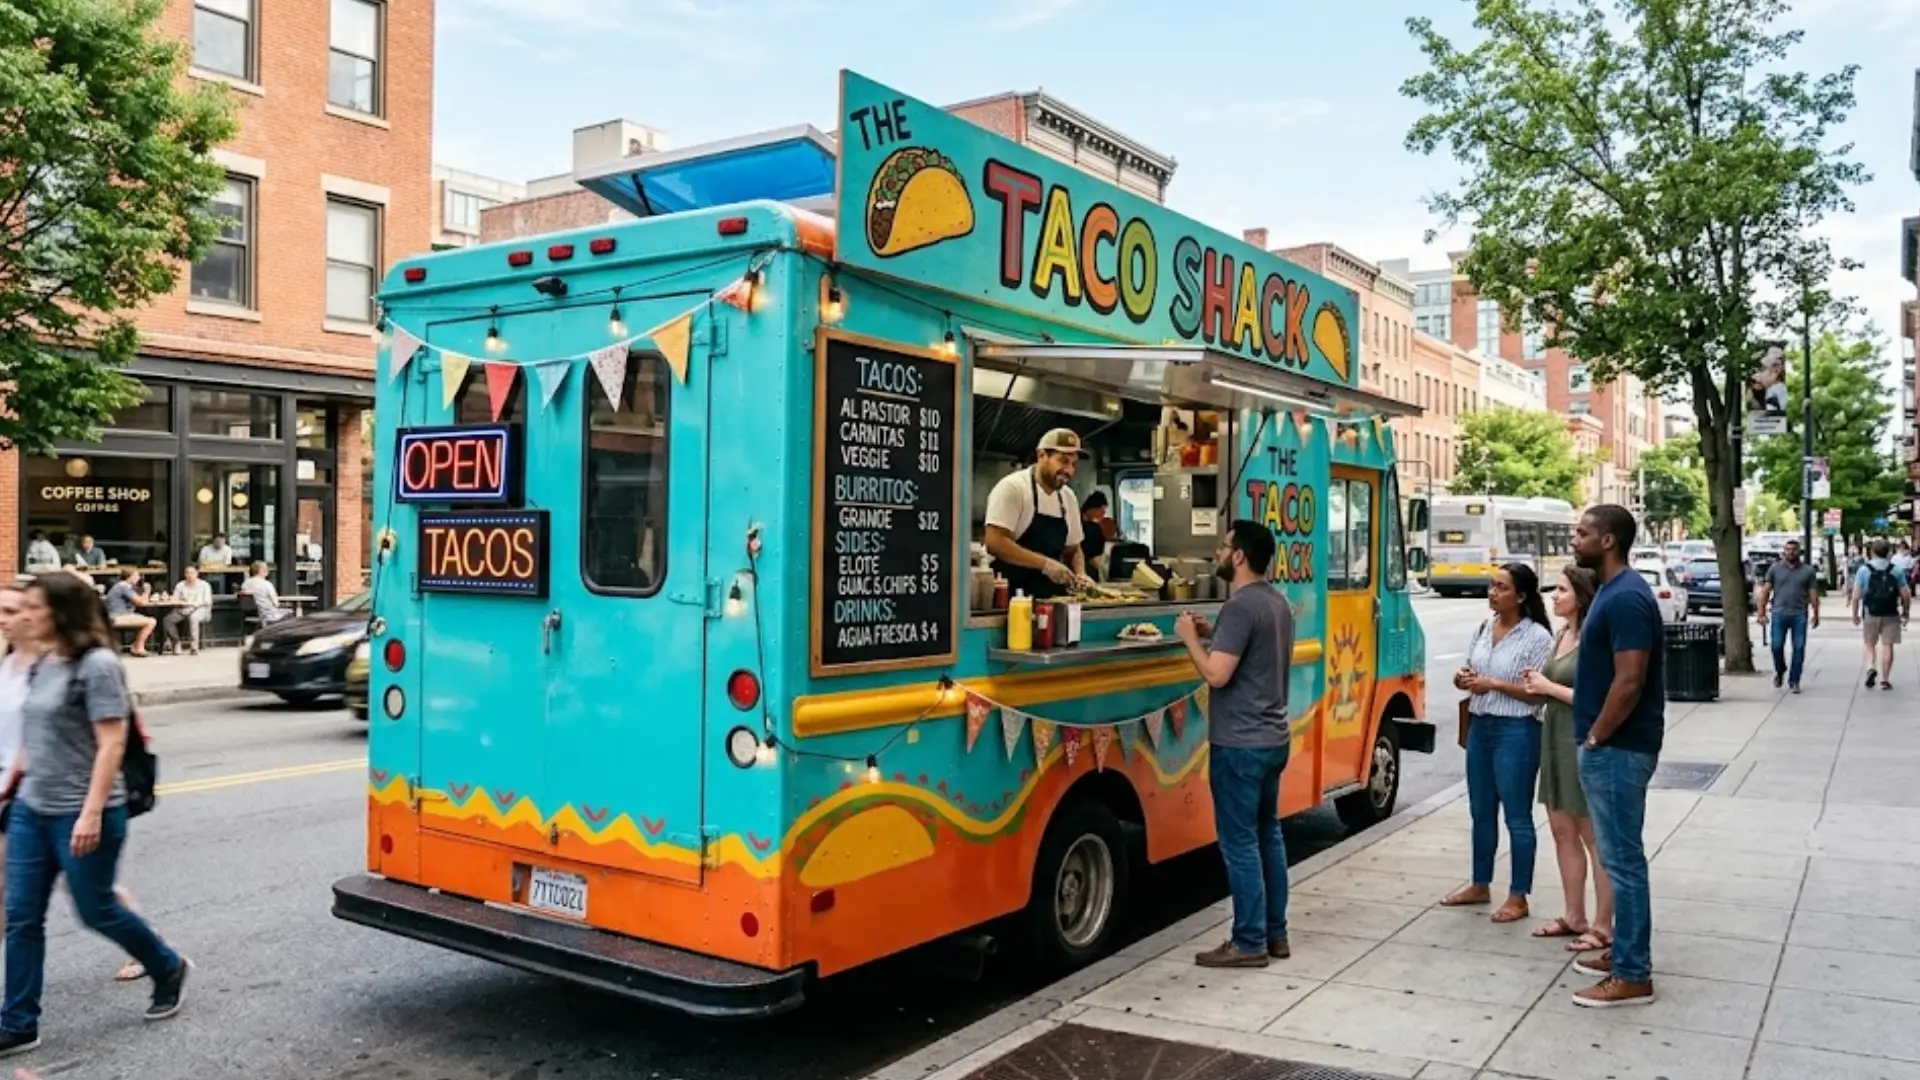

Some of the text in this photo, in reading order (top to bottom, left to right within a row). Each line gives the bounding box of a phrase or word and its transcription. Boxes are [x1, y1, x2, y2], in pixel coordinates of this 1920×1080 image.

[849, 99, 913, 150] THE
[983, 158, 1311, 371] TACO SHACK
[855, 357, 923, 395] TACOS:
[840, 398, 941, 429] AL PASTOR $10
[840, 422, 940, 452] CARNITAS $11
[404, 437, 502, 490] OPEN
[840, 444, 940, 473] VEGGIE $10
[1267, 446, 1298, 476] THE
[107, 487, 151, 501] SHOP
[834, 474, 919, 504] BURRITOS:
[918, 511, 940, 531] $12
[1246, 478, 1316, 537] TACO
[425, 528, 535, 578] TACOS
[835, 531, 886, 554] SIDES:
[838, 553, 940, 575] ELOTE $5
[837, 576, 872, 595] GUAC
[921, 574, 940, 594] $6
[834, 598, 897, 624] DRINKS:
[836, 619, 940, 648] AGUA FRESCA $4
